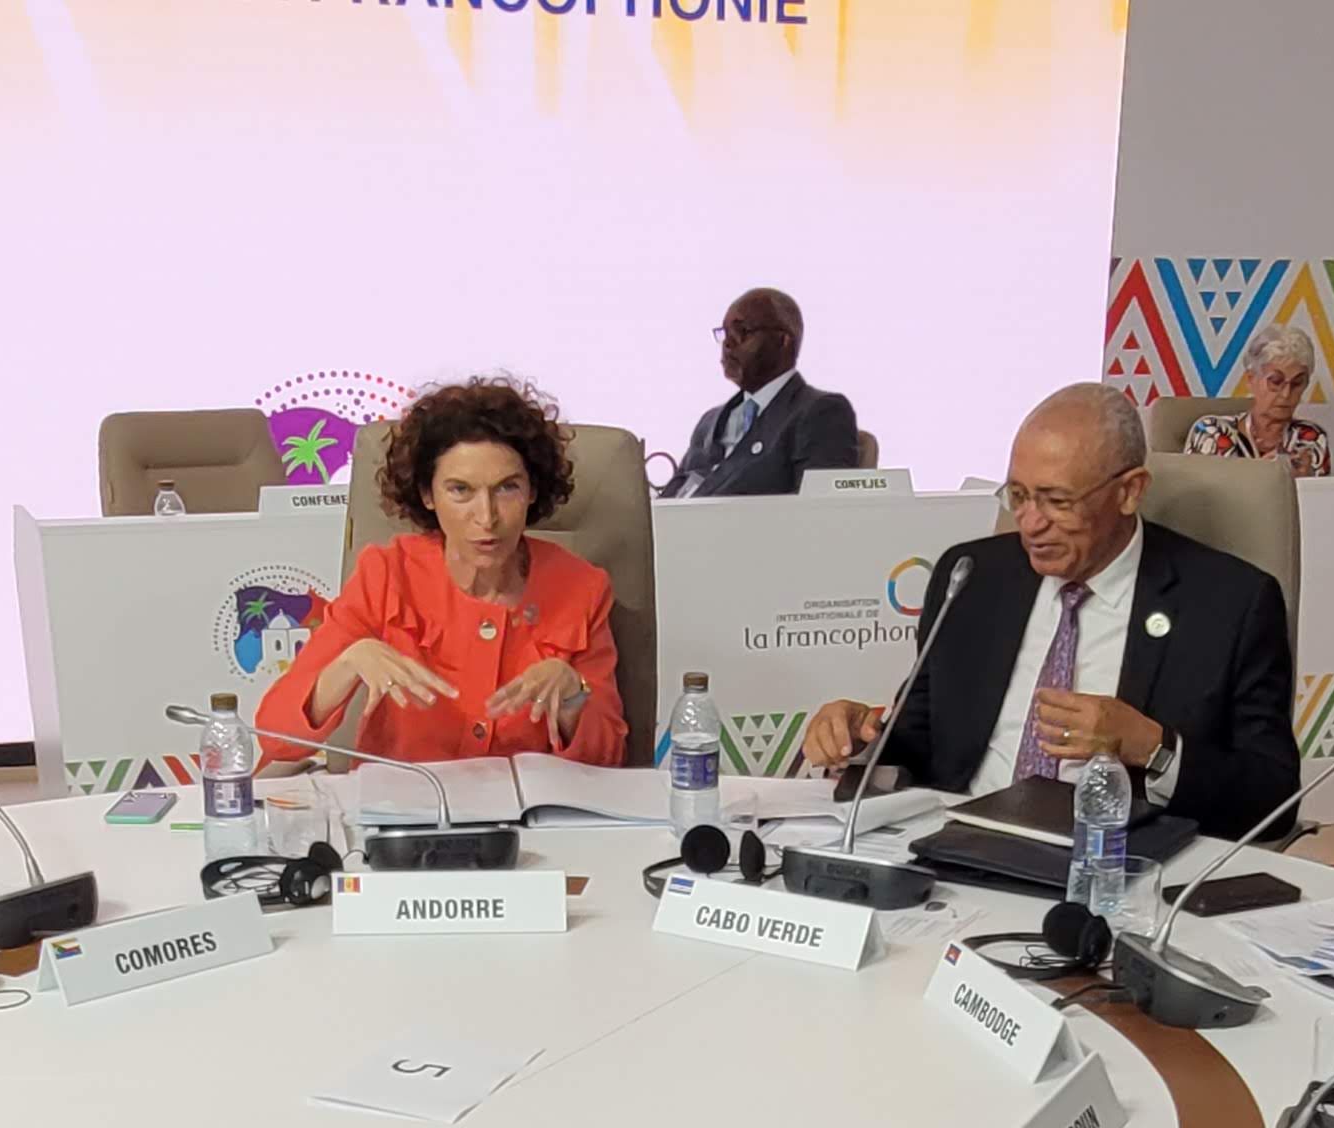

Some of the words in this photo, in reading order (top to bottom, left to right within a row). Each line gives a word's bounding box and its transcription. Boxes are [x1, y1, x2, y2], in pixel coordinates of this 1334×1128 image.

[291, 494, 348, 507] CONFEME
[803, 599, 880, 610] ORGANISATION
[776, 611, 862, 623] INTERNATIONALE
[744, 627, 768, 650] la
[776, 620, 918, 650] francophon
[395, 898, 505, 921] ANDORRE
[695, 904, 750, 933] CABO
[757, 915, 825, 948] VERDE
[114, 931, 217, 976] COMORES
[952, 982, 1021, 1047] CAMBODGE
[391, 1057, 451, 1079] 5
